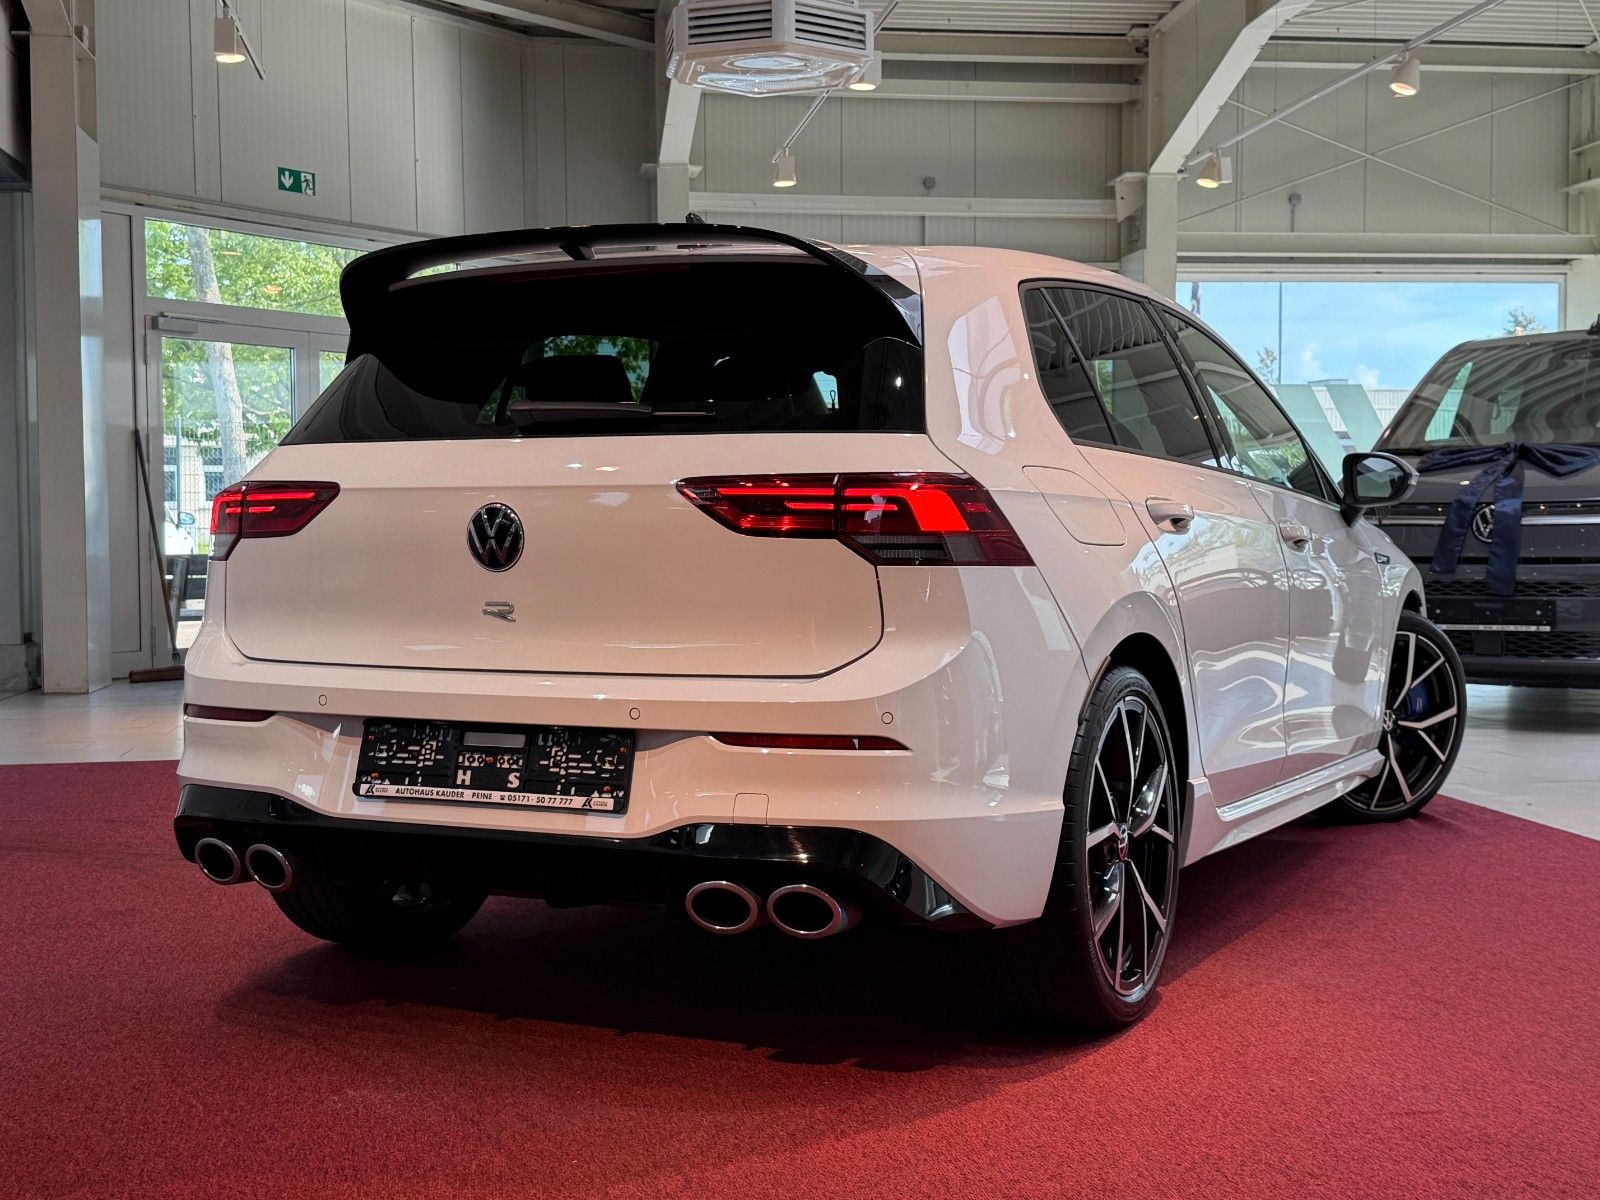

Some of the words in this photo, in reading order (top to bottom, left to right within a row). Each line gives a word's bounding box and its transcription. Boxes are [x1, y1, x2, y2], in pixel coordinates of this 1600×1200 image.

[467, 502, 525, 572] VW
[482, 601, 516, 622] R
[456, 769, 472, 786] H
[506, 772, 520, 788] S
[395, 787, 434, 796] AUTOHAUS
[435, 790, 465, 798] KAUDER
[471, 792, 493, 800] PEINE
